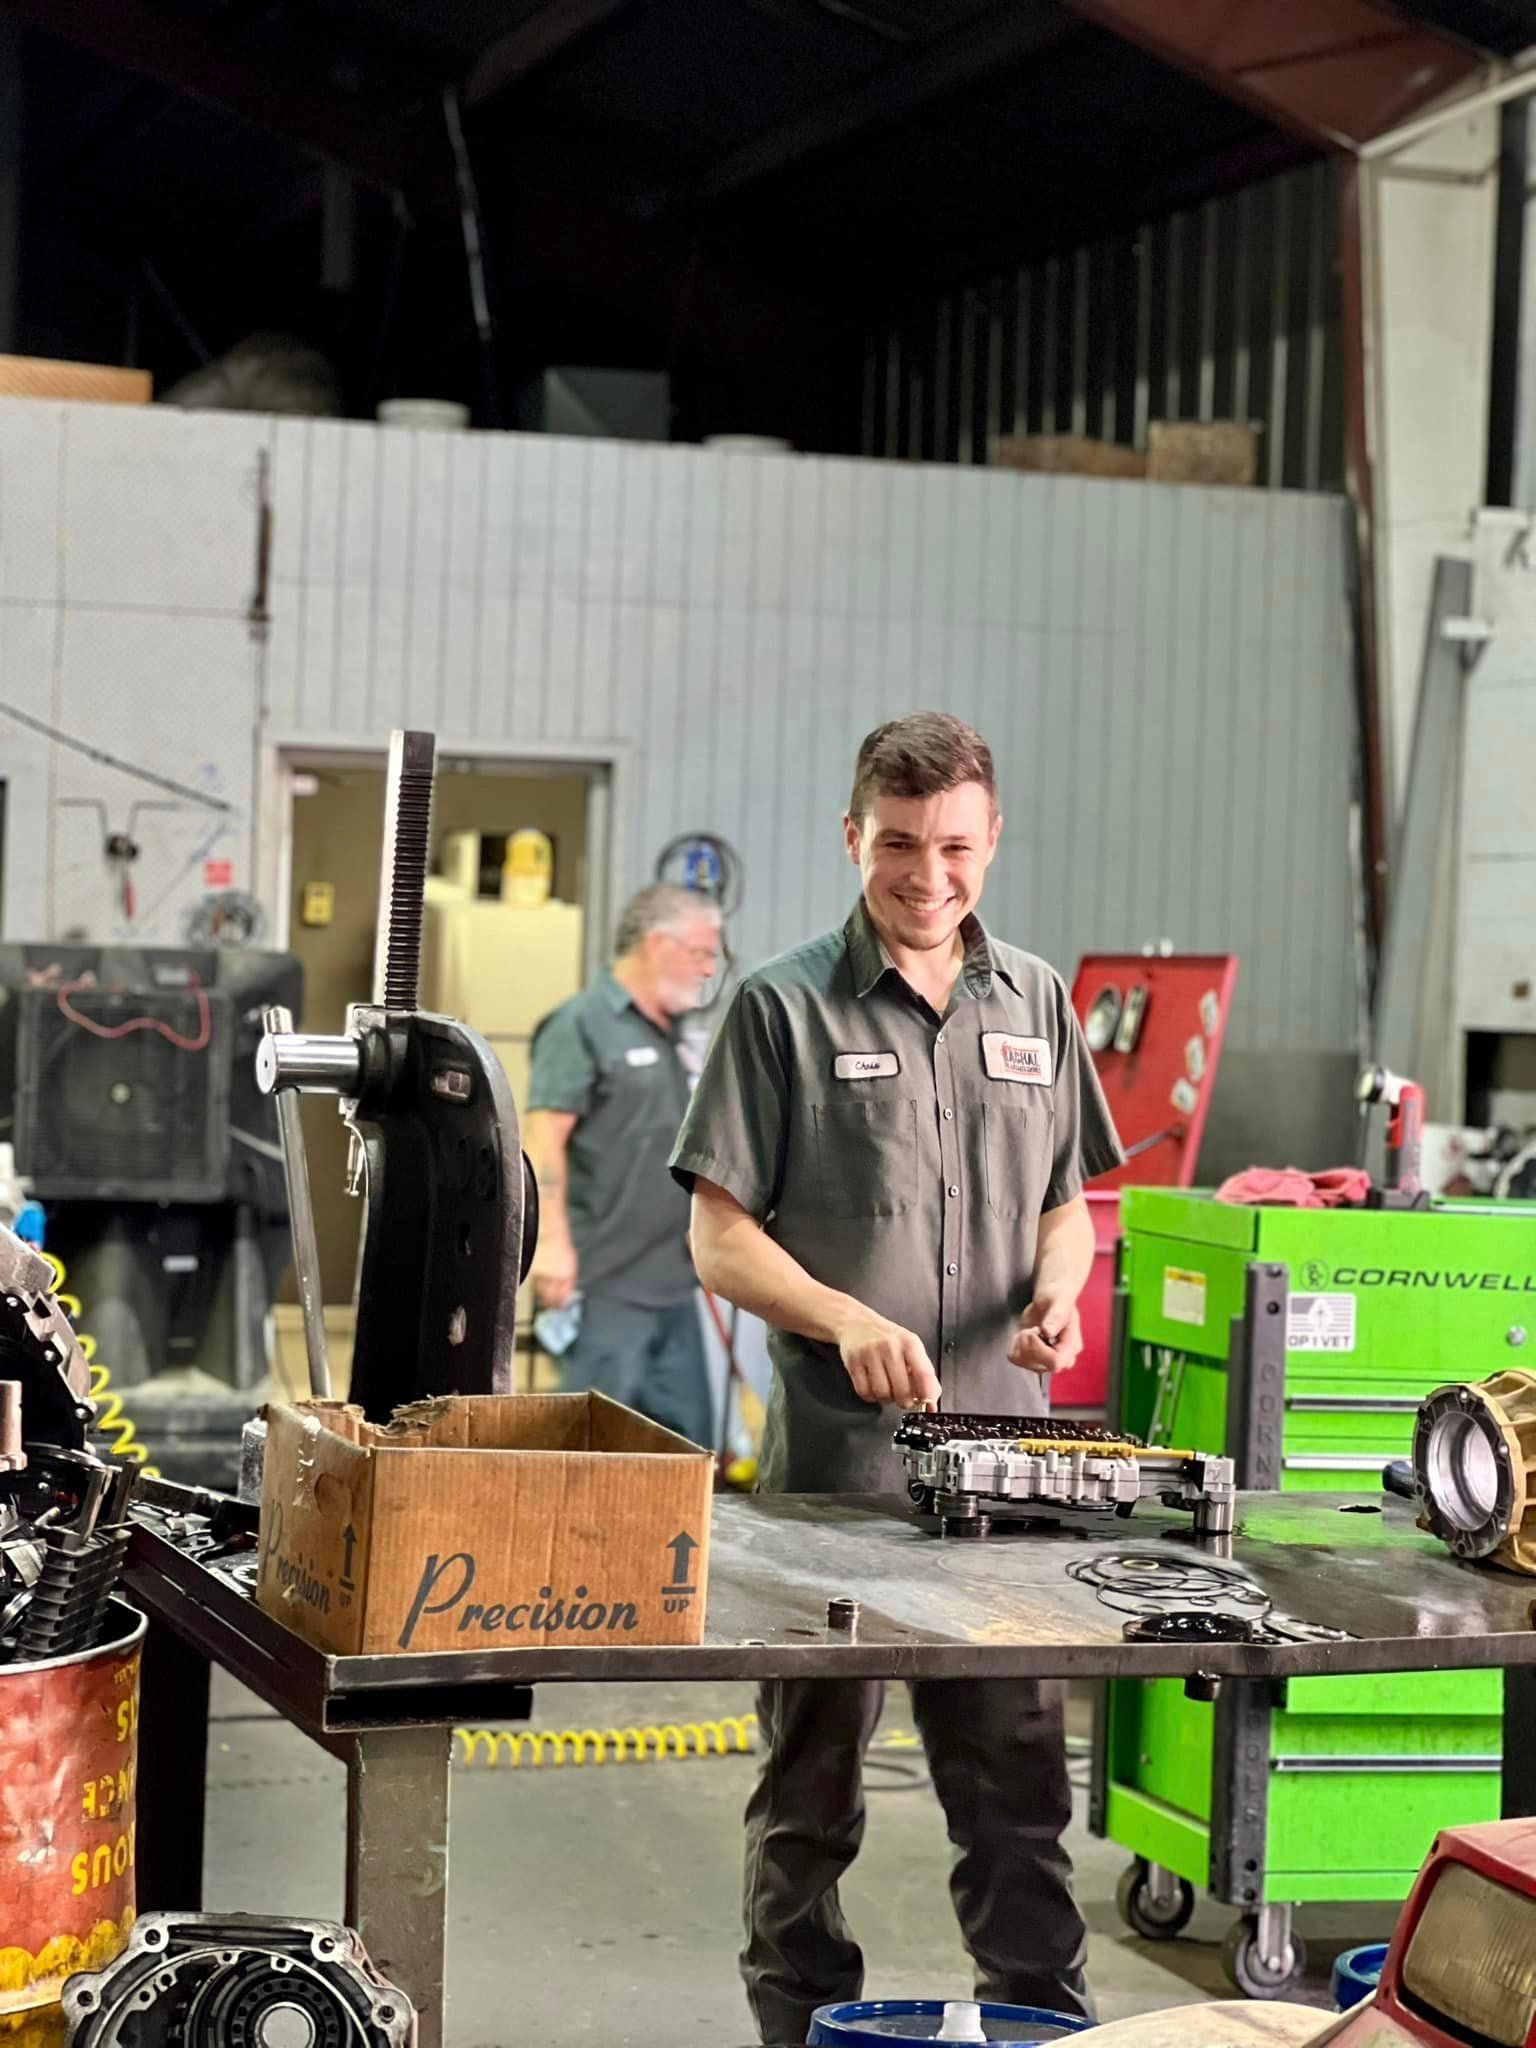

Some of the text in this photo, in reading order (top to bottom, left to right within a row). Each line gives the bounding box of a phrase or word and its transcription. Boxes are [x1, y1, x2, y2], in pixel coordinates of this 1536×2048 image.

[1333, 1268, 1536, 1291] CORNWELL
[397, 1552, 638, 1649] Precision
[664, 1601, 690, 1613] UP
